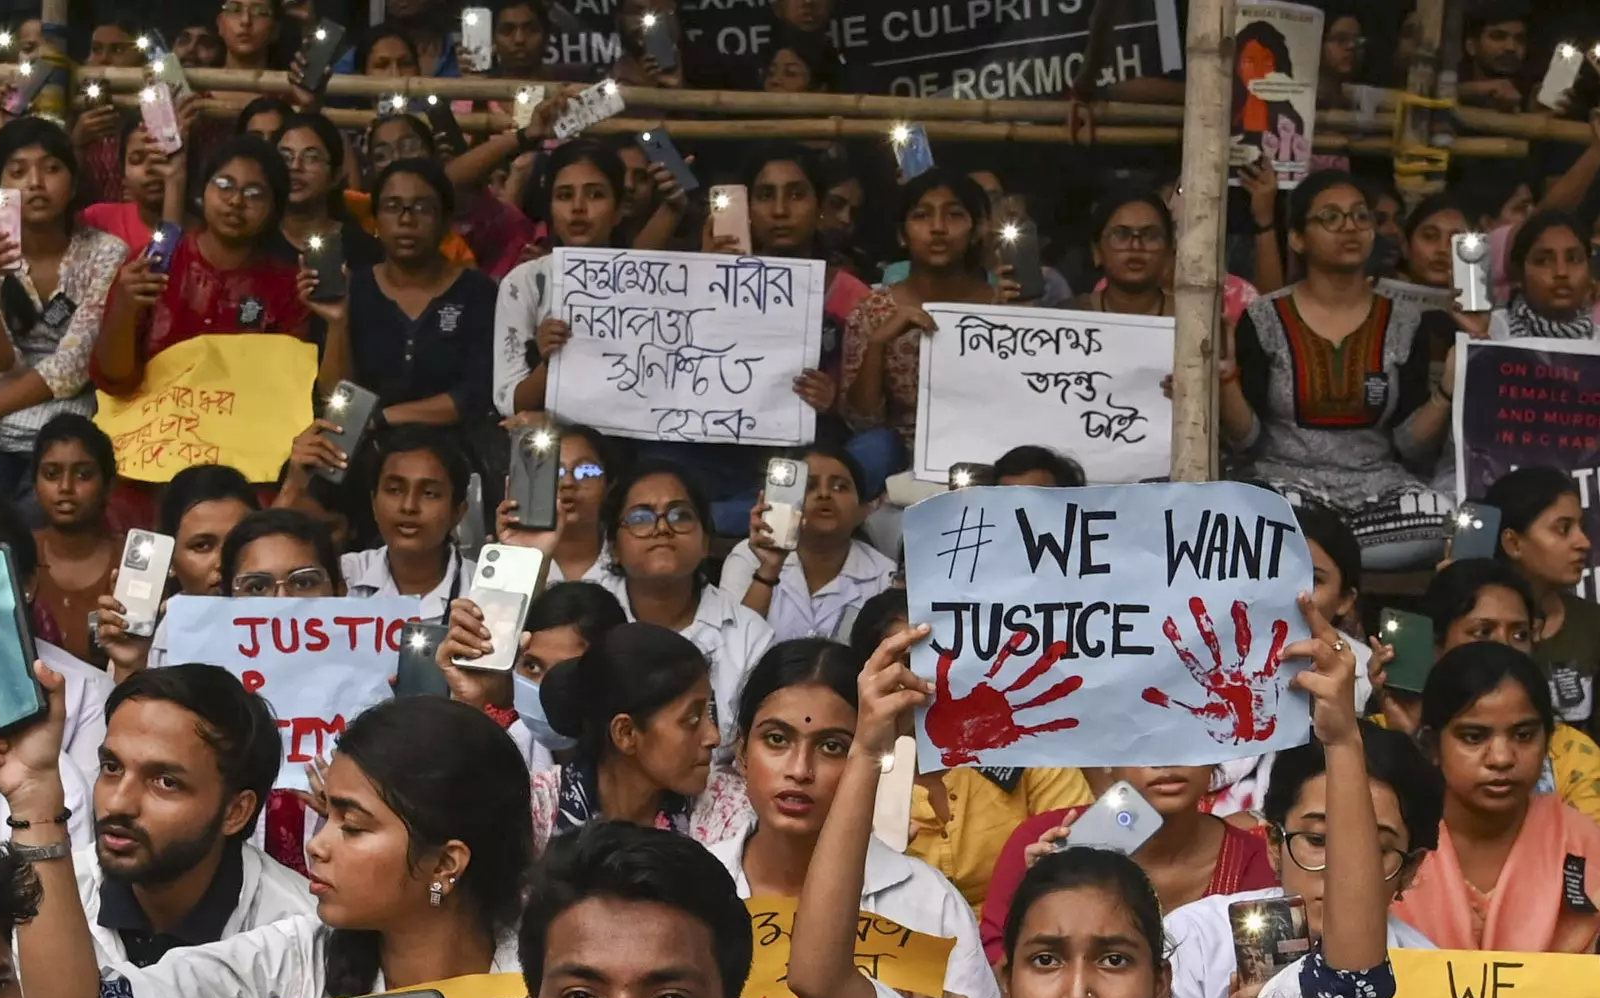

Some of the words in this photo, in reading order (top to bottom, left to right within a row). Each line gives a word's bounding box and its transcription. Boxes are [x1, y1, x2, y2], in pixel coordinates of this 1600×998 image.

[709, 256, 794, 315] নারীর
[955, 315, 1103, 360] নিরপেক্ষ
[1020, 370, 1113, 405] তদন্ত
[1499, 362, 1528, 377] ON
[651, 407, 757, 442] হোক
[1080, 393, 1149, 444] চাই
[1014, 504, 1116, 580] WE
[1166, 509, 1298, 587] WANT
[233, 616, 421, 659] JUSTIC
[928, 601, 1155, 662] JUSTICE
